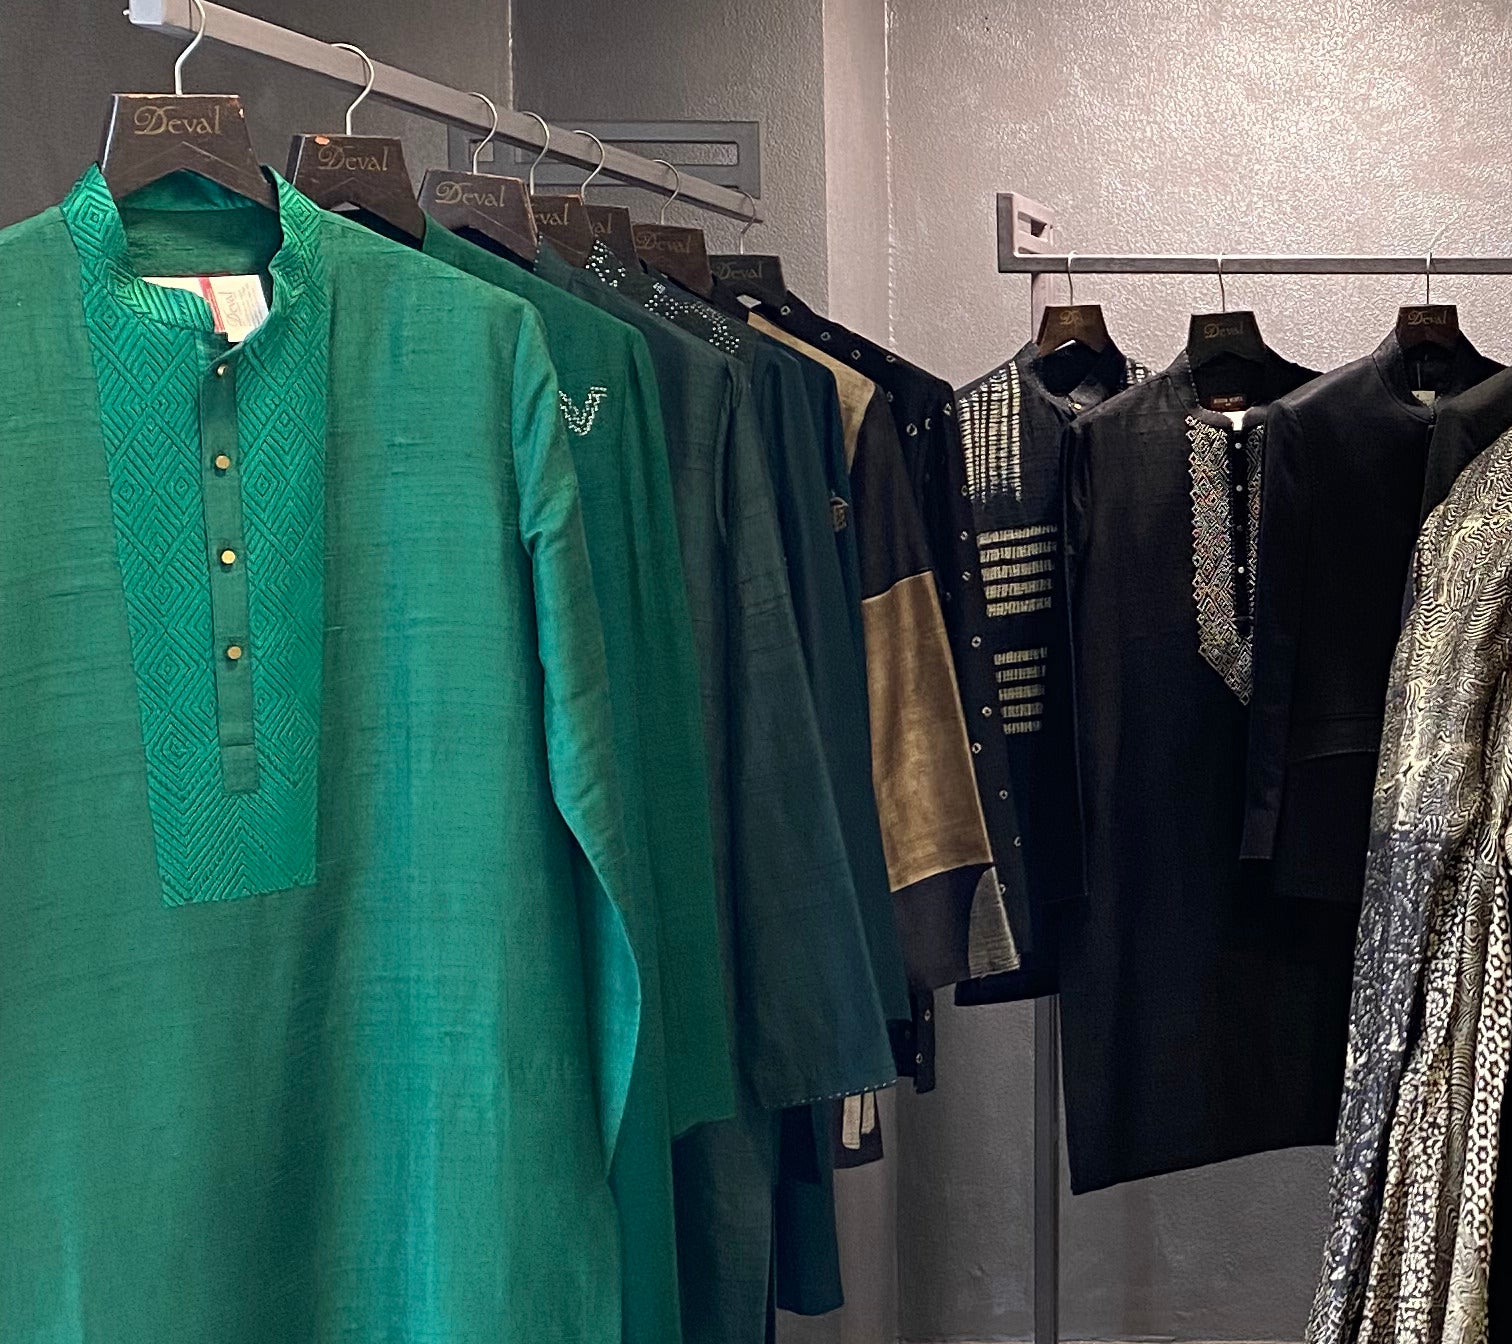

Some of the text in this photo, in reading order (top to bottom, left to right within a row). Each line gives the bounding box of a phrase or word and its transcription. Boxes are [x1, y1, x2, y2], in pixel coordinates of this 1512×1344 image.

[134, 106, 224, 135] Deval
[318, 145, 389, 171] Deval
[435, 181, 505, 207] Deval
[636, 232, 691, 253] Deval
[716, 262, 762, 280] Deval
[1407, 310, 1447, 325] Deval
[1204, 323, 1244, 339] Deval
